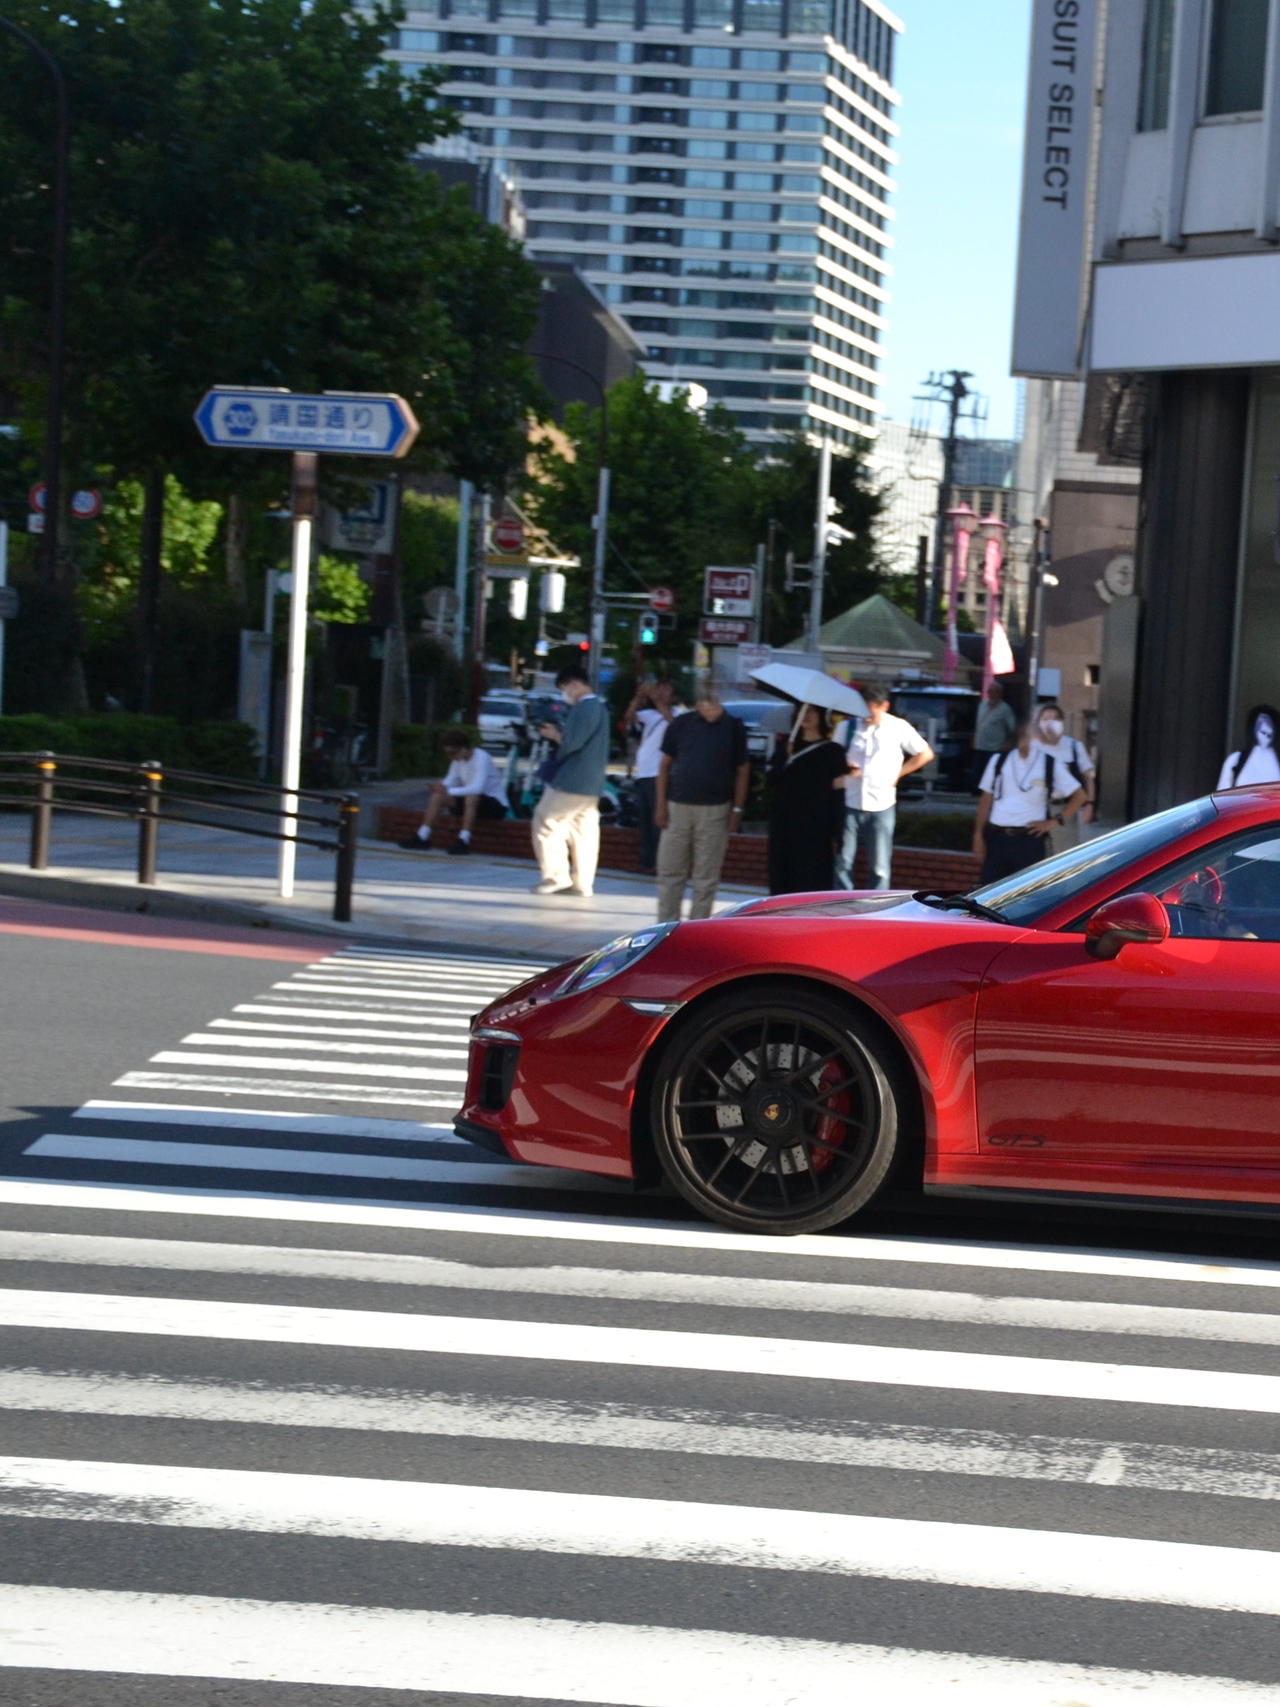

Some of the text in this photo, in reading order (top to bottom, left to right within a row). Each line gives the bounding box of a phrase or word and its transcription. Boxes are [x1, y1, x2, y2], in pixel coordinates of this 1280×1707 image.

[1043, 0, 1079, 210] SUIT SELECT
[269, 403, 373, 430] 靖国通り
[988, 1133, 1046, 1147] GTS
